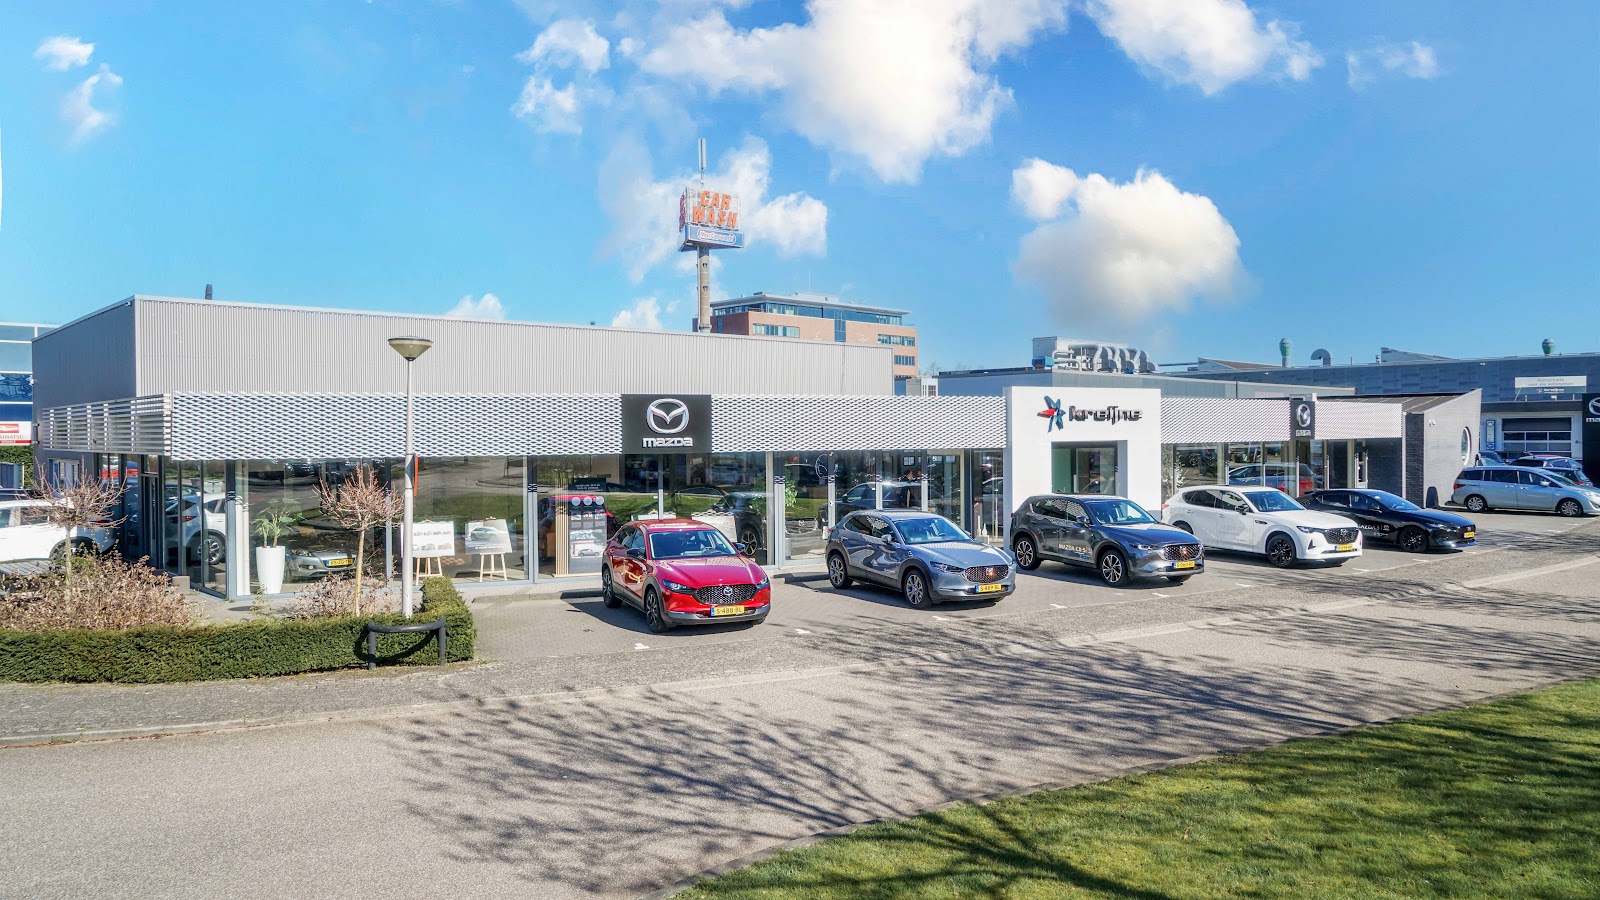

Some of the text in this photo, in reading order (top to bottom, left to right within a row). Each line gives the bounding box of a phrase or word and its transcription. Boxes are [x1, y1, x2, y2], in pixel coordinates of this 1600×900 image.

[700, 191, 731, 210] CAR
[693, 206, 737, 228] WASH
[642, 437, 693, 447] mazda
[1058, 543, 1075, 551] MAZDA
